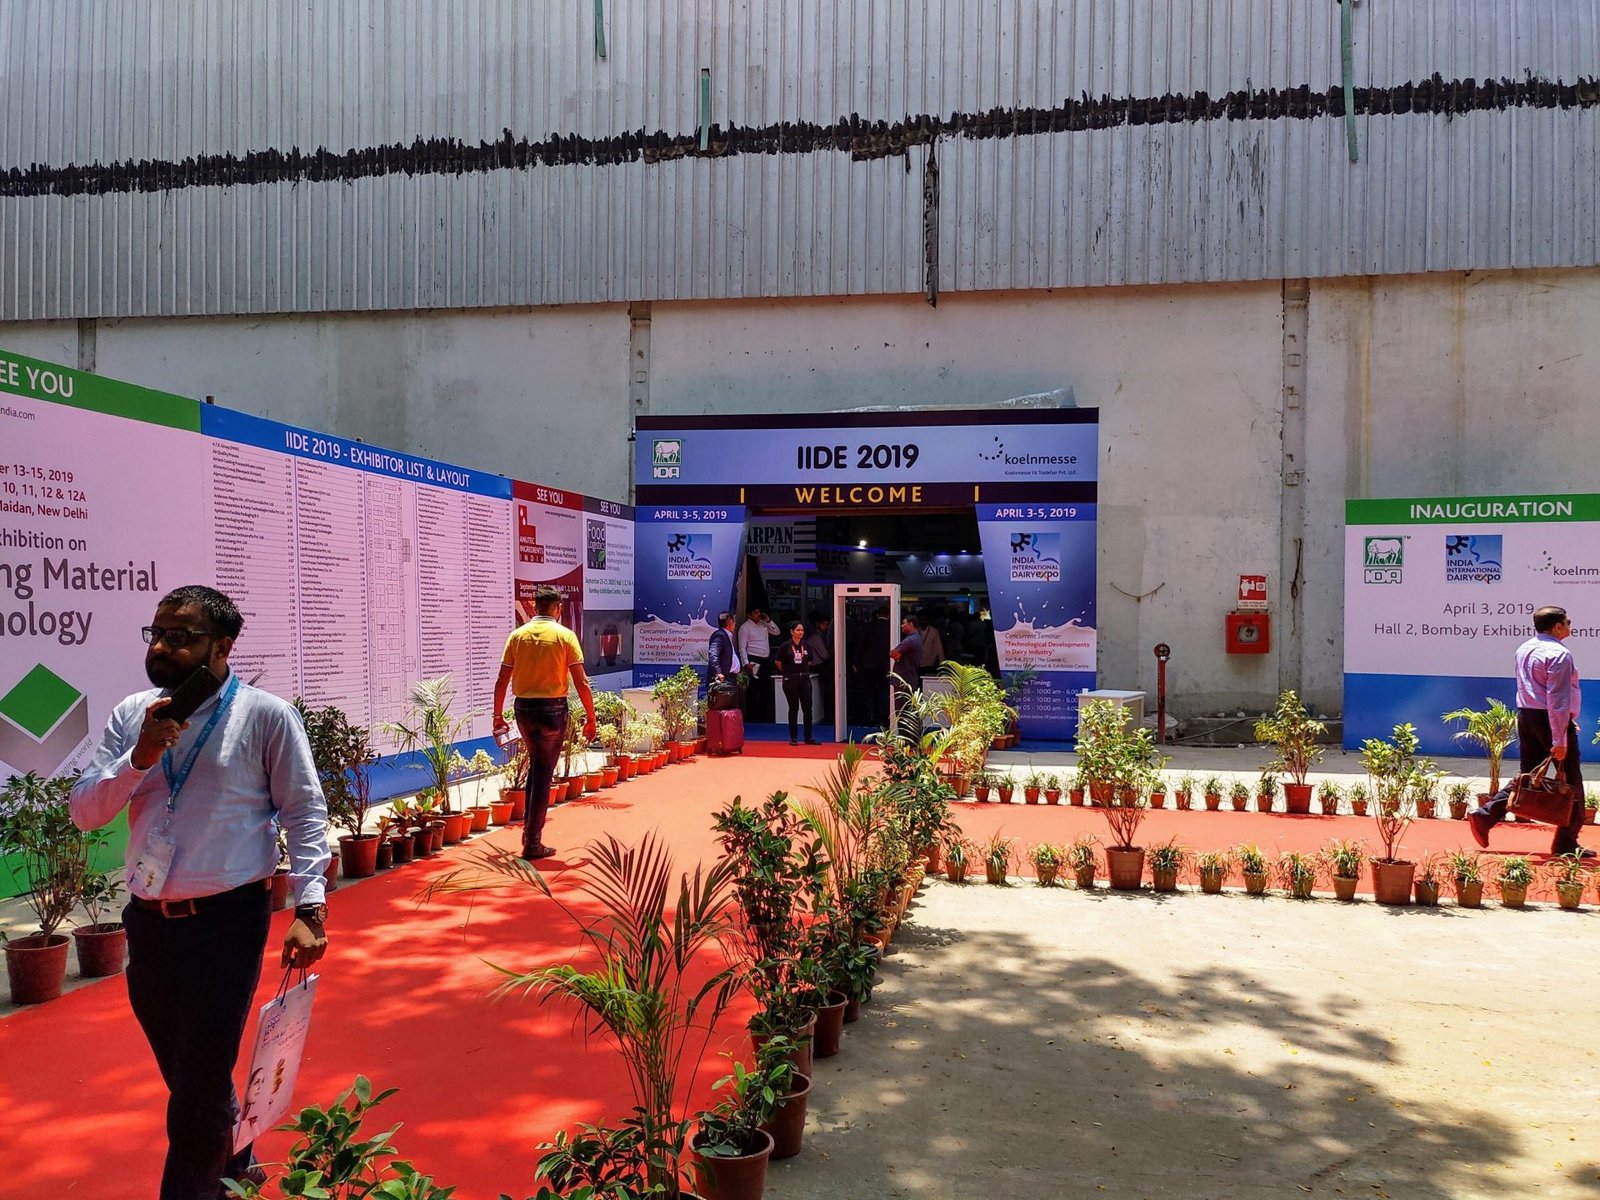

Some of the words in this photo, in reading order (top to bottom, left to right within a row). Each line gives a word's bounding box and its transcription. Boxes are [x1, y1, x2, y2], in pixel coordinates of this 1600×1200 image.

[26, 366, 74, 398] YOU
[285, 431, 310, 452] IIDE
[312, 438, 341, 459] 2019
[351, 447, 404, 474] EXHIBITOR
[406, 462, 425, 479] LIST
[426, 464, 435, 480] &
[436, 467, 470, 488] LAYOUT
[797, 446, 848, 469] IIDE
[856, 444, 919, 469] 2019
[1005, 453, 1077, 465] koelnmesse
[13, 464, 46, 481] 13-15,
[48, 469, 74, 483] 2019
[653, 466, 681, 479] IDA
[3, 481, 19, 497] 10,
[22, 483, 38, 499] 11,
[41, 486, 53, 499] 12
[56, 488, 65, 500] &
[68, 489, 87, 502] 12A
[536, 488, 548, 501] SEE
[548, 491, 564, 505] YOU
[795, 486, 922, 504] WELCOME
[0, 499, 35, 517] aidan,
[37, 504, 61, 517] New
[63, 506, 89, 520] Delhi
[600, 501, 609, 513] SEE
[610, 503, 621, 515] YOU
[654, 511, 680, 519] APRIL
[682, 511, 701, 520] 3-5,
[703, 511, 728, 519] 2019
[995, 509, 1024, 518] APRIL
[1026, 508, 1047, 519] 3-5,
[1050, 508, 1077, 518] 2019
[1410, 501, 1572, 519] INAUGURATION
[0, 528, 64, 550] hibition
[68, 538, 87, 551] on
[760, 545, 776, 554] PVT.
[778, 545, 793, 554] LTD.
[43, 557, 159, 592] Material
[1364, 569, 1402, 584] IDA
[1443, 603, 1475, 617] April
[1481, 603, 1493, 616] 3,
[1497, 603, 1535, 615] 2019
[1374, 623, 1401, 635] Hall
[1406, 624, 1417, 637] 2,
[1421, 624, 1478, 639] Bombay
[1483, 624, 1536, 637] Exhibiti
[1569, 626, 1600, 637] entr
